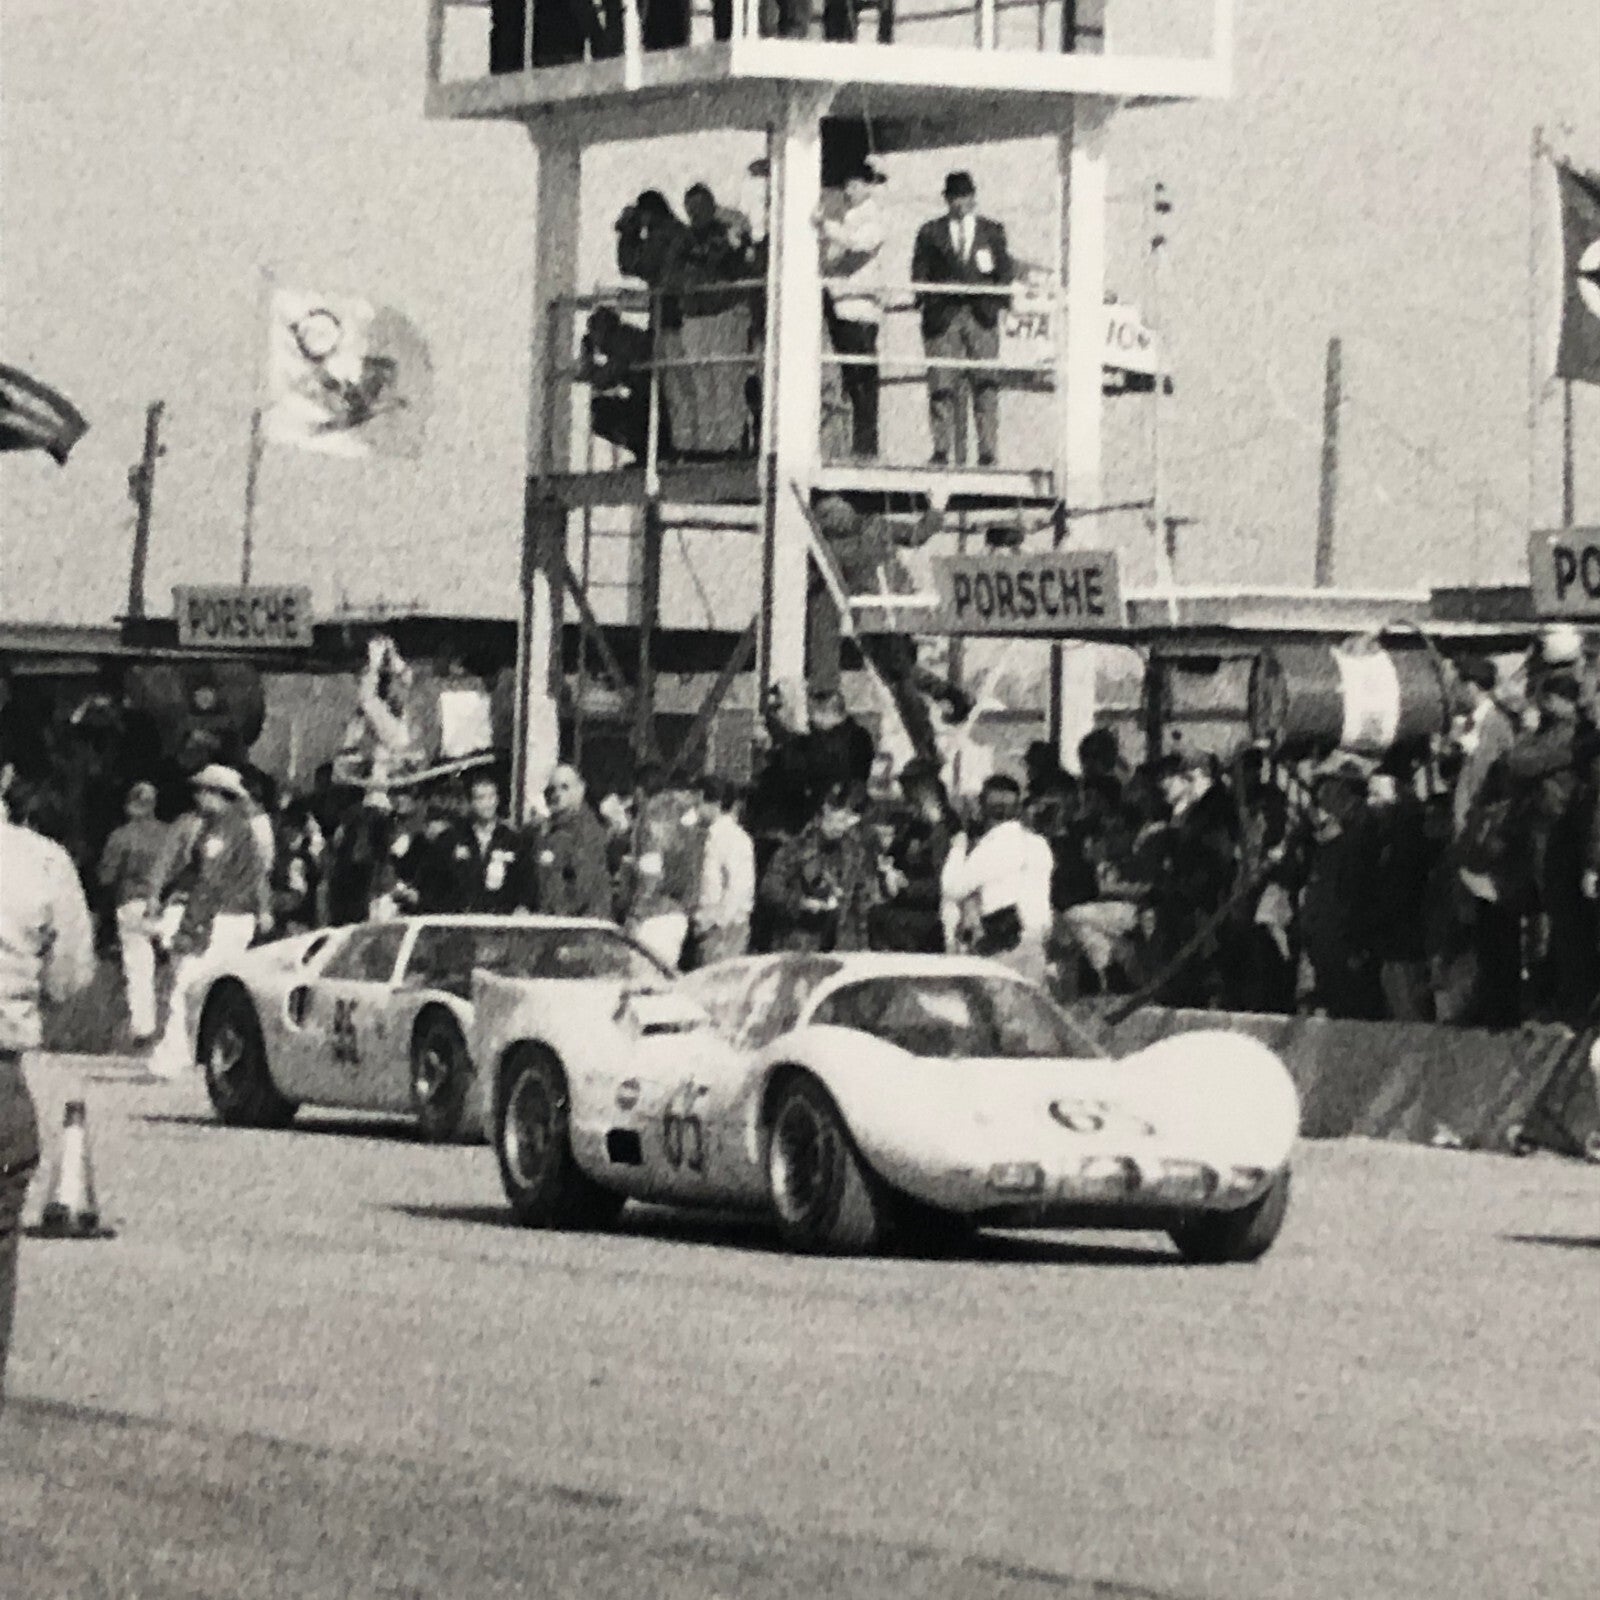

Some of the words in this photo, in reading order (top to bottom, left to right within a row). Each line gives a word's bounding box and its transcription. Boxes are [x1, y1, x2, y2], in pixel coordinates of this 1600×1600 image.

[953, 565, 1104, 621] PORSCHE
[1552, 543, 1600, 600] PO
[187, 596, 298, 638] PORSCHE
